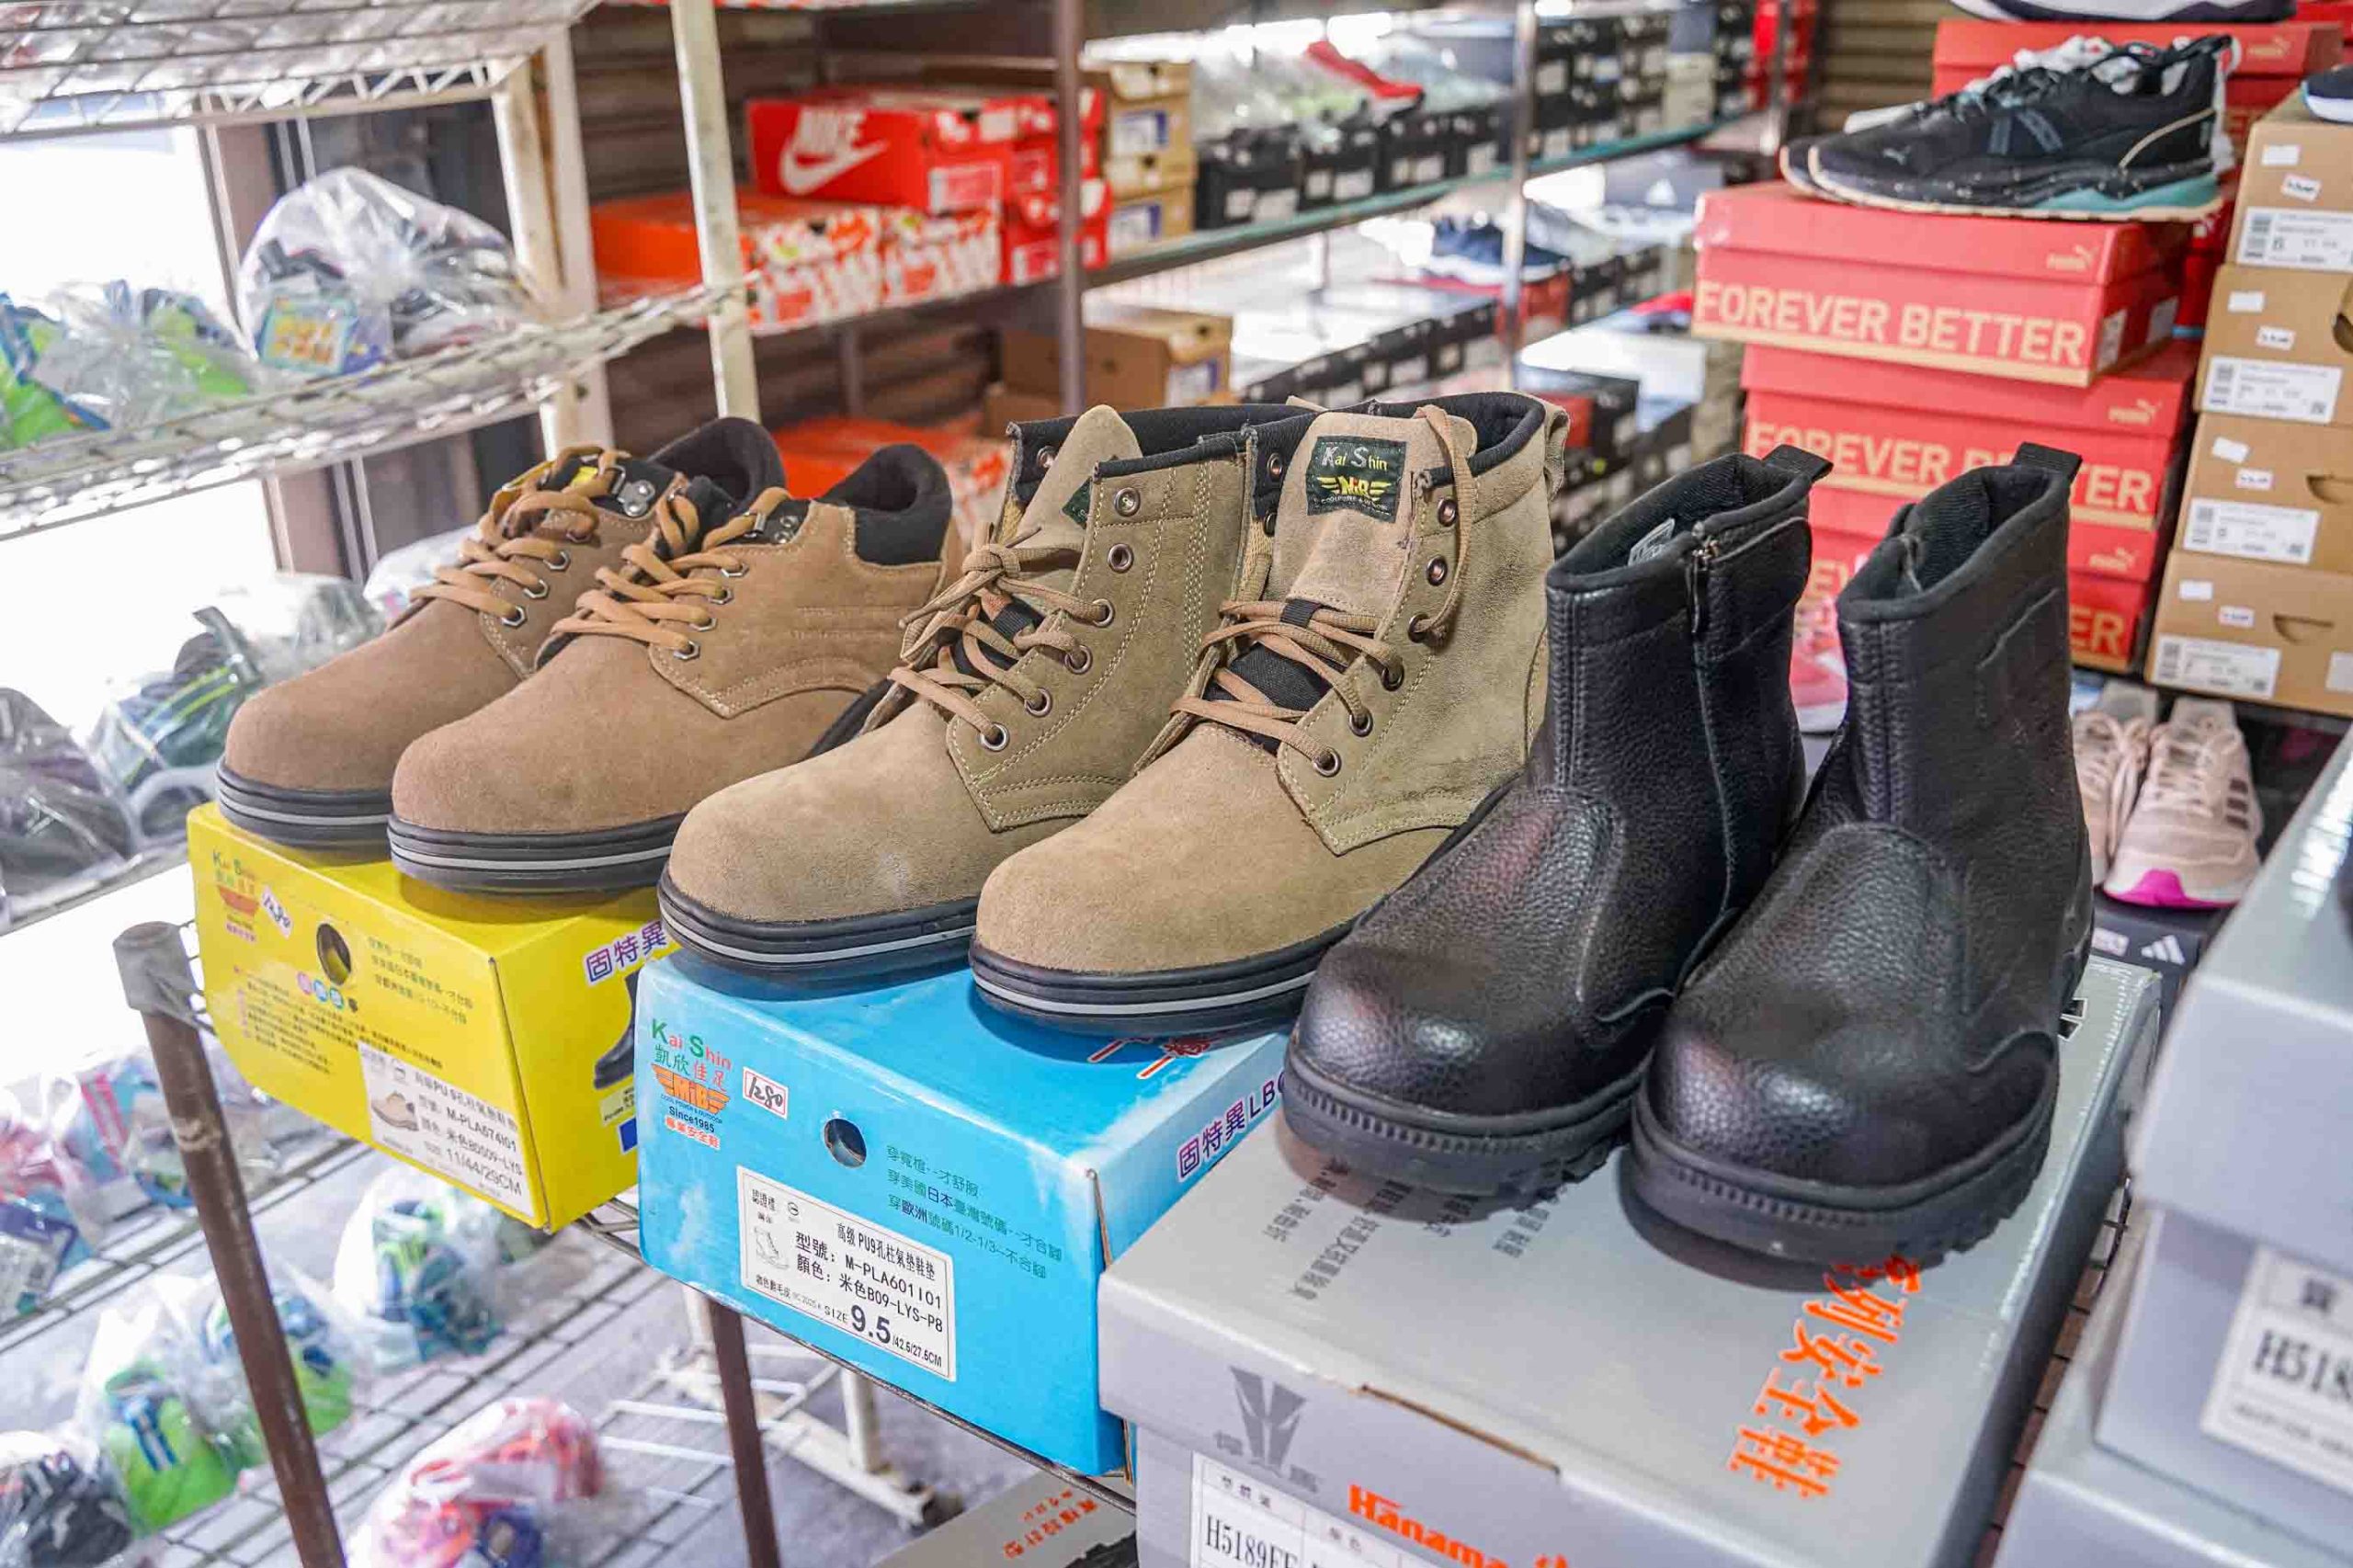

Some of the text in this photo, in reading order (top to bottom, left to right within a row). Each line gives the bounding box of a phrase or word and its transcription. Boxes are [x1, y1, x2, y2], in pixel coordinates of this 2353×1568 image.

[1695, 278, 2086, 366] FOREVER BETTER
[1321, 446, 1388, 472] Kai Shin
[585, 921, 668, 983] 固特異
[652, 1018, 733, 1073] Kai Shin
[749, 1076, 784, 1109] 1280
[824, 1305, 848, 1324] SIZE
